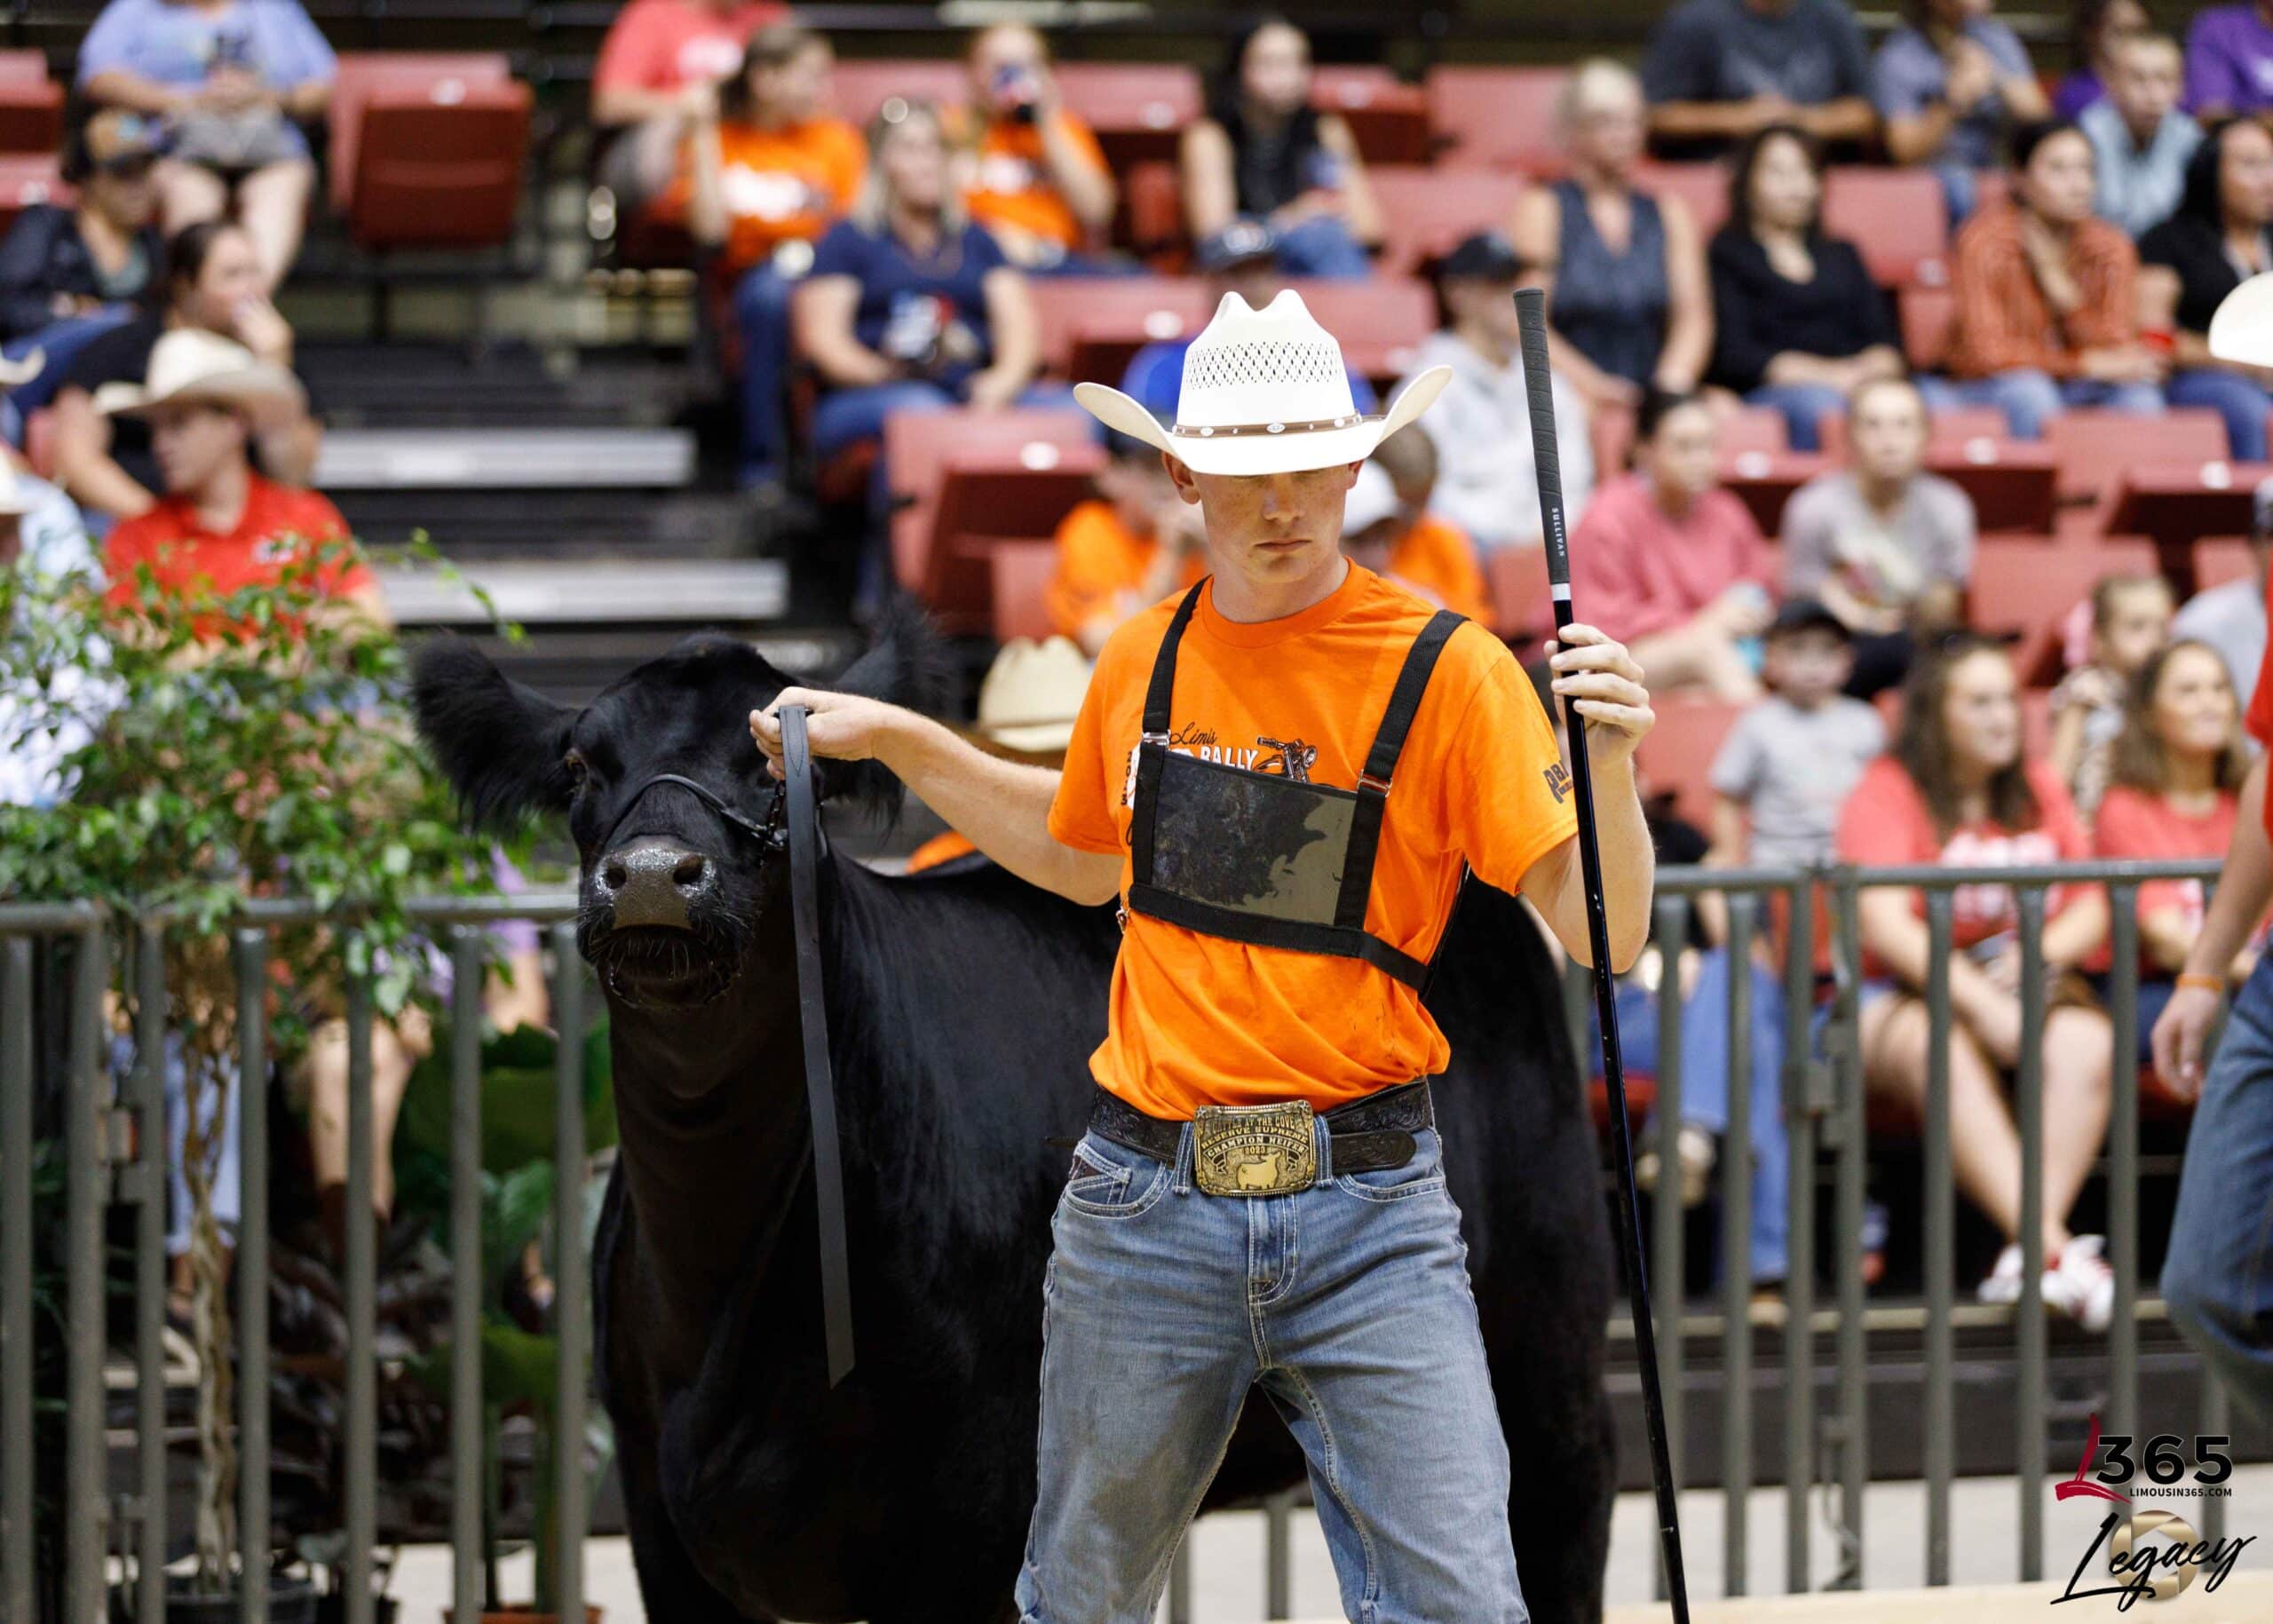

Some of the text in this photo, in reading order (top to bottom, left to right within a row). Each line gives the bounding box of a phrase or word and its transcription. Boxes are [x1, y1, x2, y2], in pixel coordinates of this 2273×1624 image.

[1551, 507, 1565, 557] SULLIVAN
[1256, 1116, 1272, 1127] THE
[1275, 1114, 1295, 1129] COVE
[1201, 1127, 1309, 1149] RESERVE SUPREME
[1208, 1136, 1305, 1157] CHAMPION HEIFER
